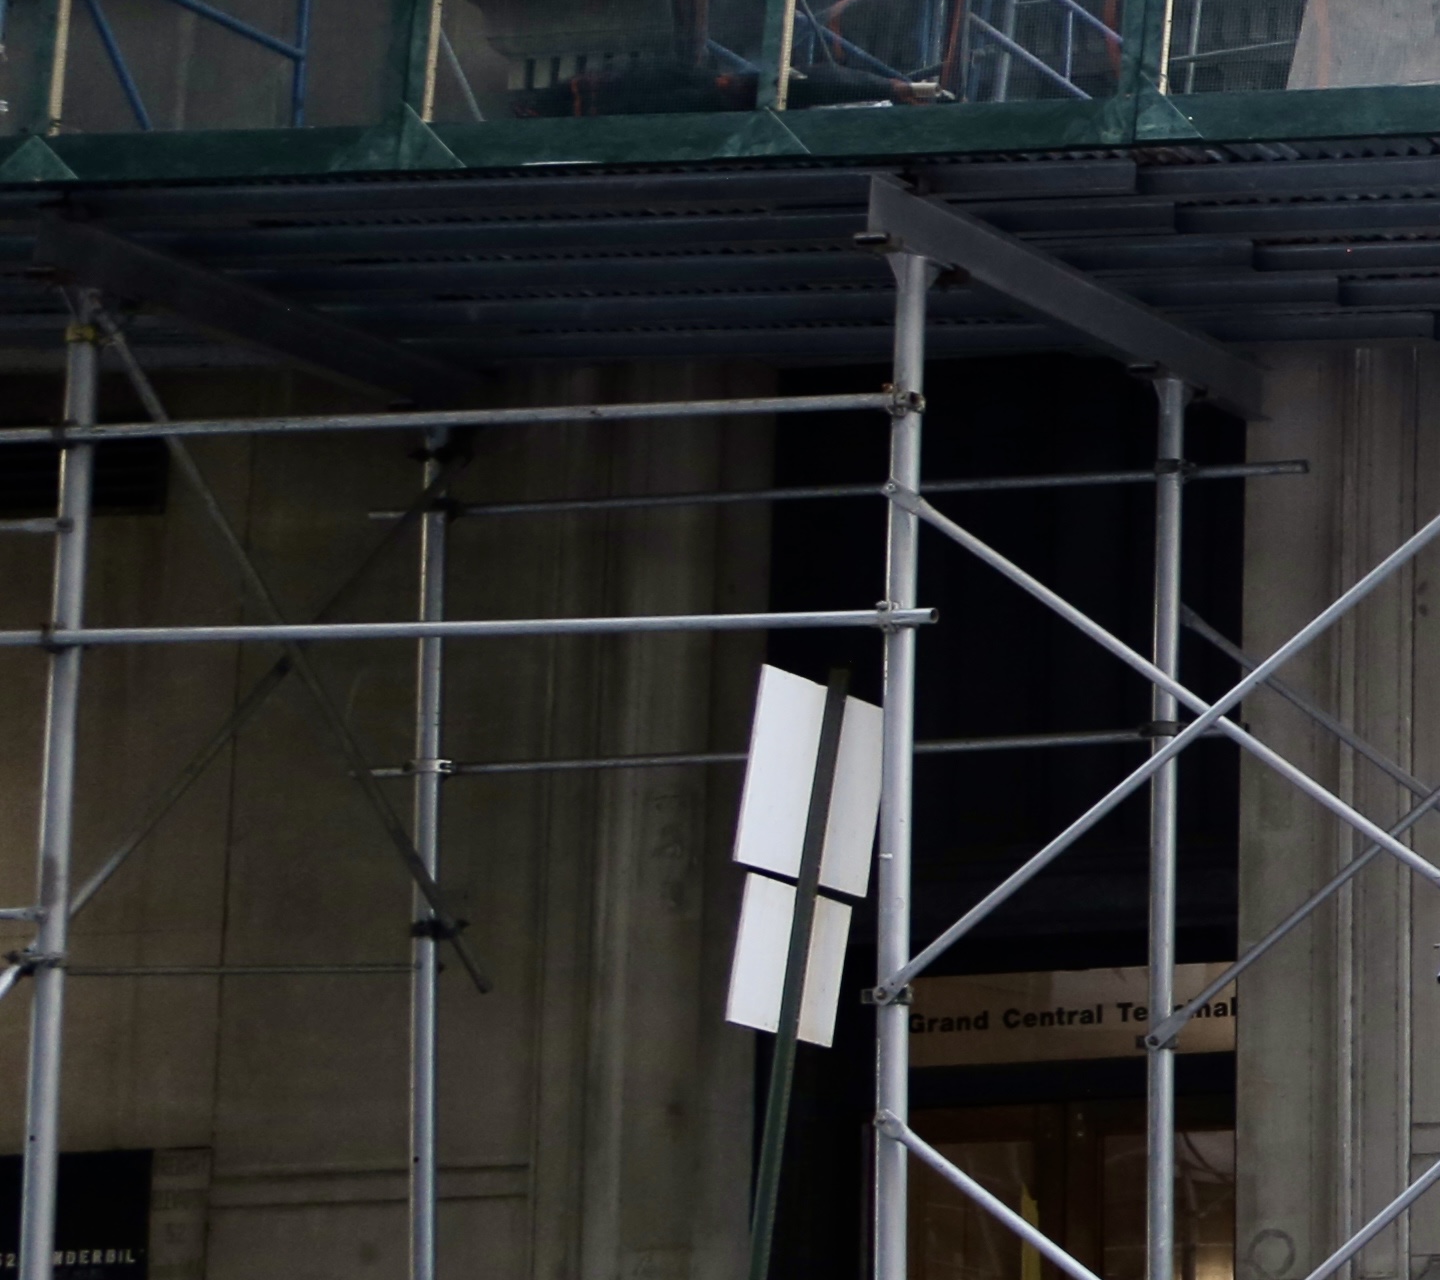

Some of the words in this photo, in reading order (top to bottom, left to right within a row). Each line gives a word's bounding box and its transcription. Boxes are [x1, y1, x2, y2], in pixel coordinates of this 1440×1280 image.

[909, 1011, 989, 1033] Grand
[1003, 1004, 1102, 1029] Central
[1117, 997, 1237, 1023] Tenal
